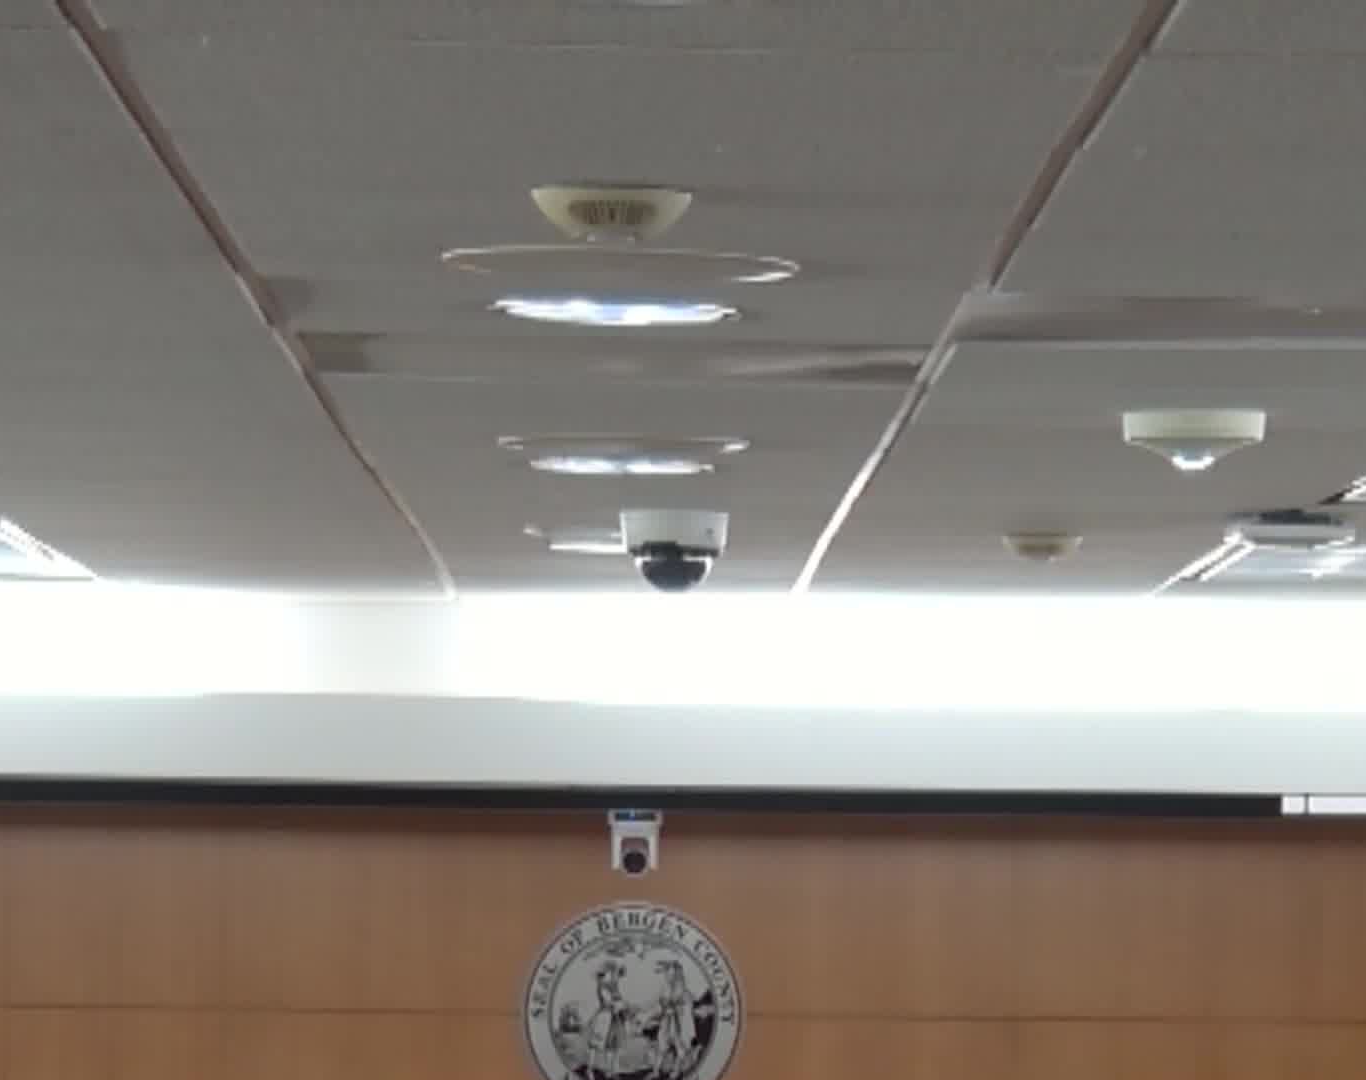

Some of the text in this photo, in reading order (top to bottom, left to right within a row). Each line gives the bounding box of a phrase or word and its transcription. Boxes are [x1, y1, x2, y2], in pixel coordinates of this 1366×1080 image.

[531, 911, 734, 1023] SEAL OF BERGEN COUNTY
